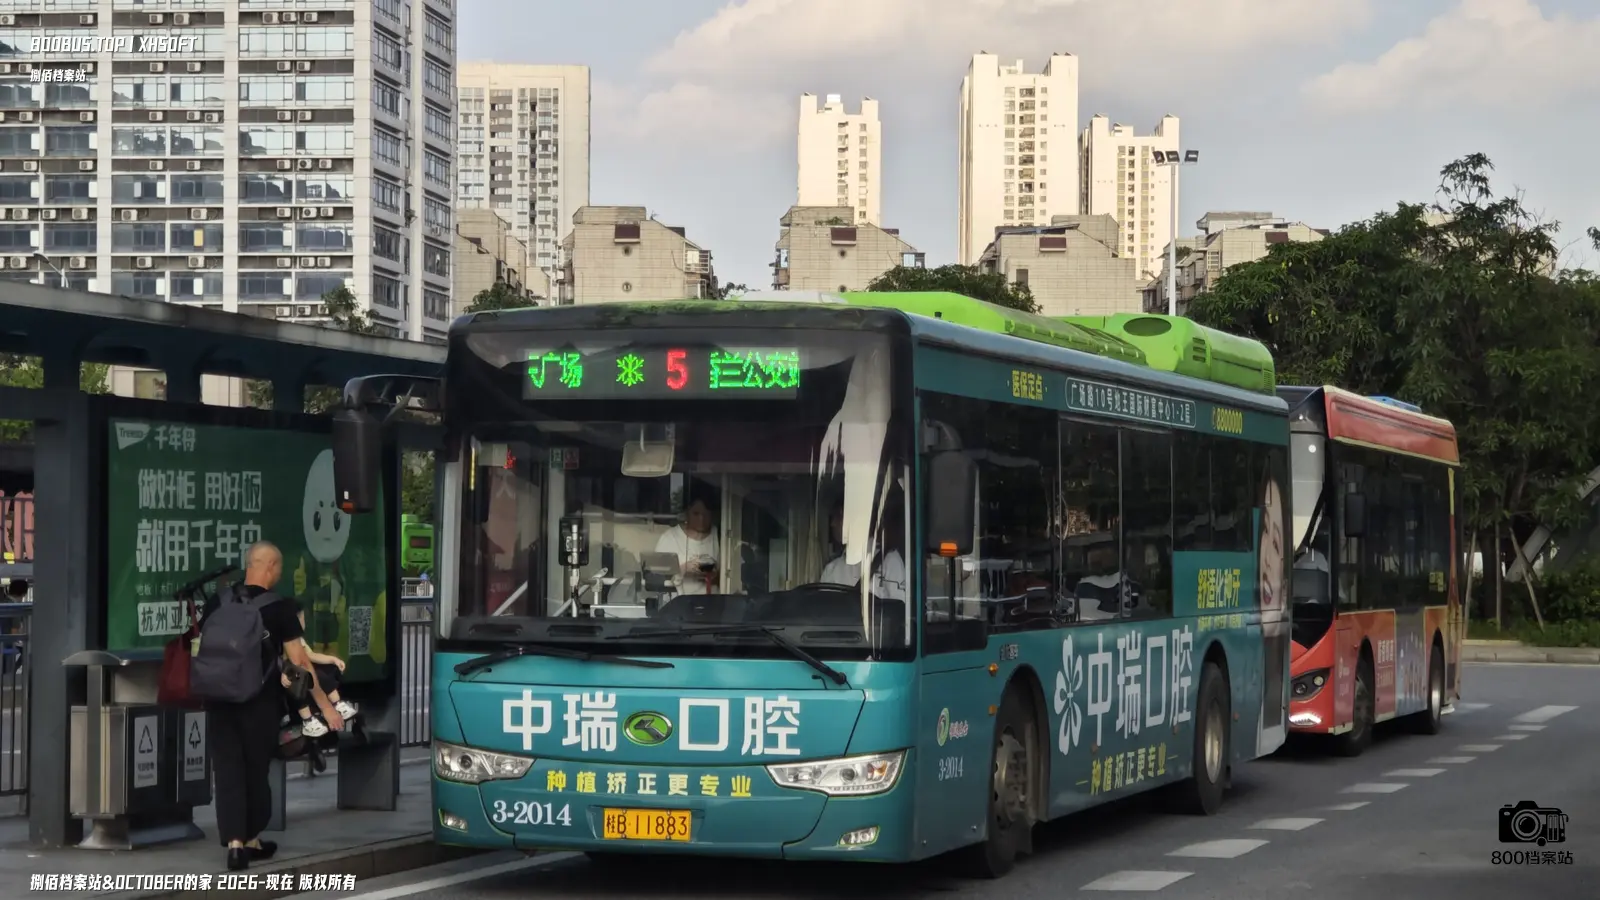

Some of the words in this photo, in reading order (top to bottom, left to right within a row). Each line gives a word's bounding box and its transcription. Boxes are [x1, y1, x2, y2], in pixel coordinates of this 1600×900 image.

[666, 350, 688, 390] 5
[154, 425, 196, 451] 千年舟
[138, 468, 196, 510] 做好柜
[1087, 624, 1194, 747] 中瑞口腔
[502, 690, 618, 752] 中瑞
[679, 696, 801, 755] 口腔
[546, 770, 752, 797] 种植矫正更专业
[938, 756, 963, 781] 3-2014
[1090, 742, 1167, 796] 种植矫正更专业
[492, 800, 571, 827] 3-2014
